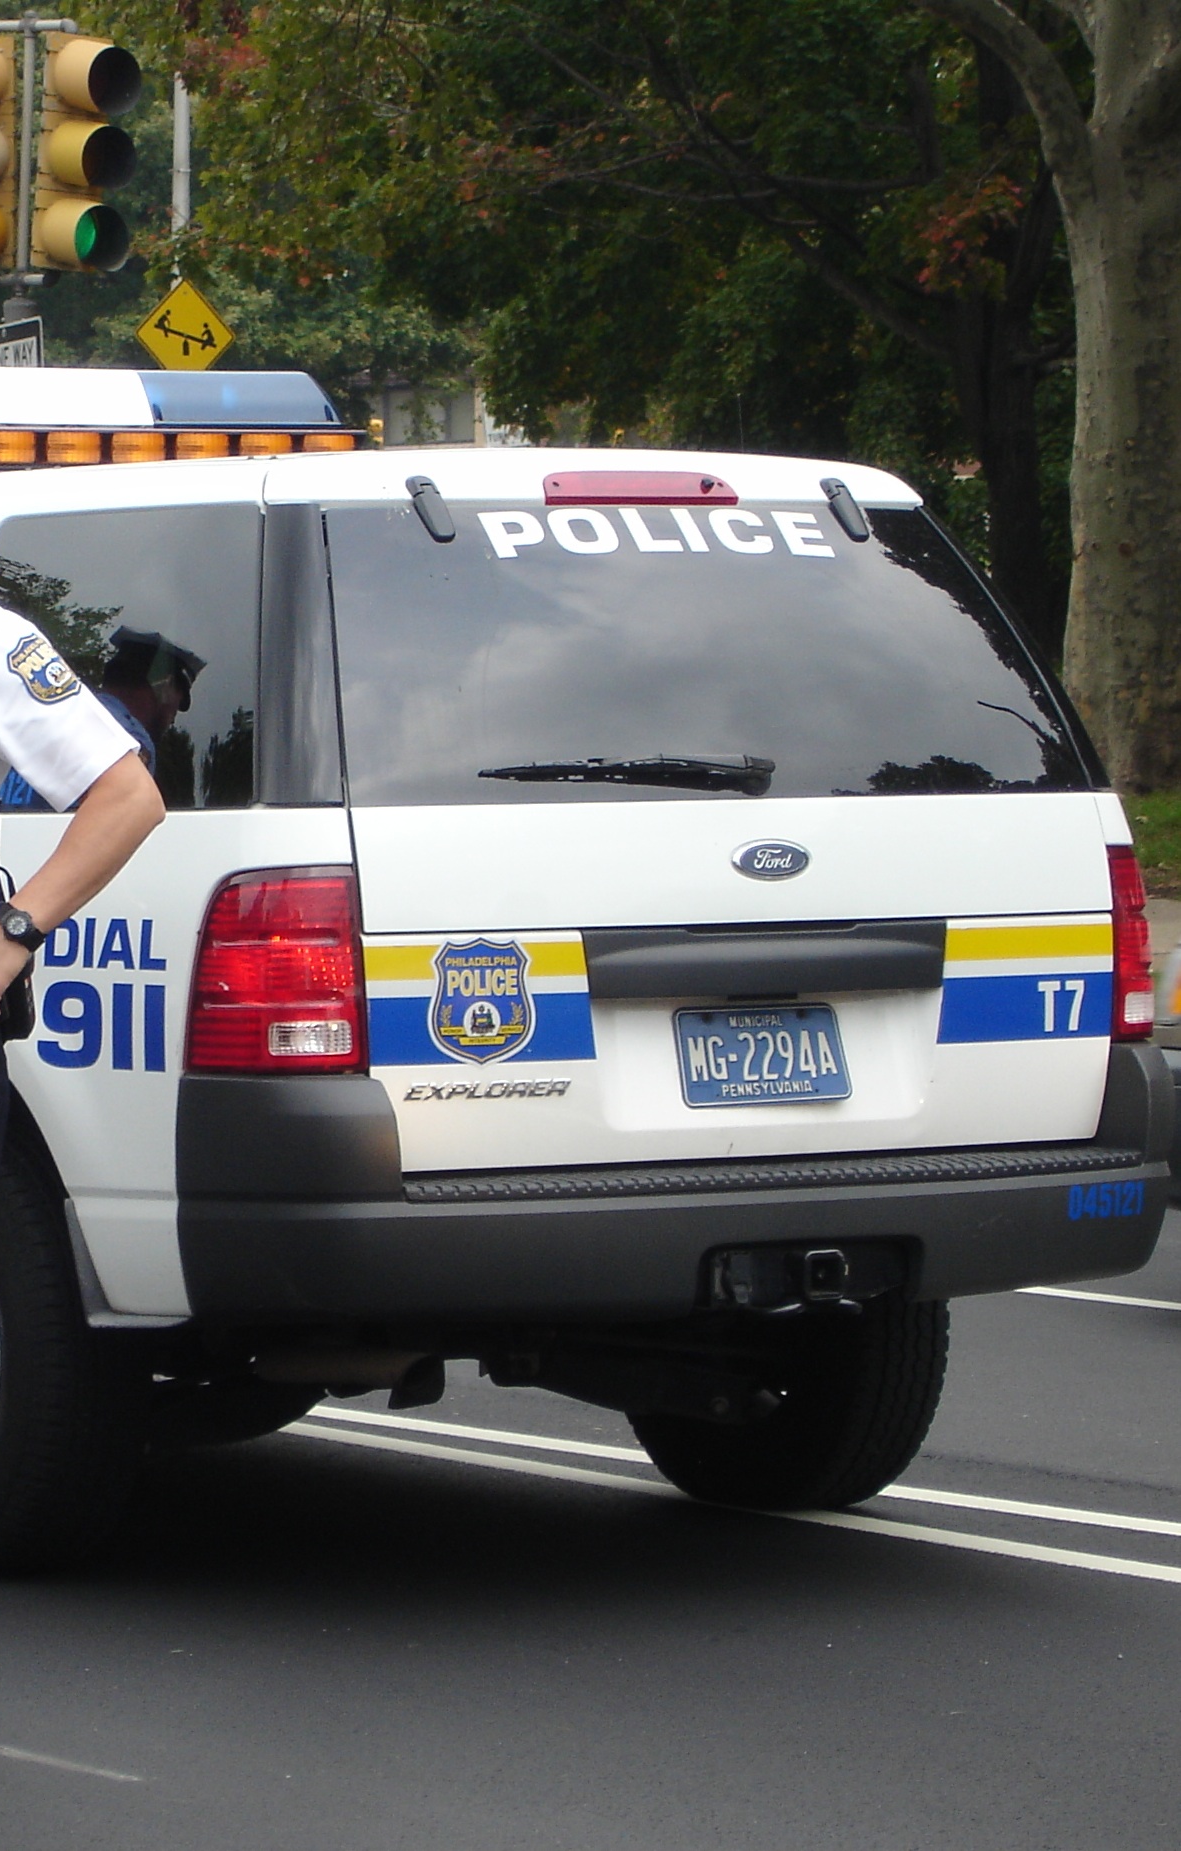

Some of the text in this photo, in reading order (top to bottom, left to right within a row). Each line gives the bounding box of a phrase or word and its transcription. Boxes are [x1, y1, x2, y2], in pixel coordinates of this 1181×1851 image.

[11, 340, 34, 367] WAY
[476, 507, 836, 560] POLICE
[753, 848, 793, 870] Ford
[43, 917, 167, 971] DIAL
[445, 955, 518, 967] PHILADELPHIA
[446, 968, 519, 997] POLICE
[1037, 979, 1085, 1033] T7
[37, 980, 167, 1073] 911
[728, 1014, 783, 1029] MUNICIPAL
[686, 1029, 839, 1084] MG-2294A
[403, 1077, 572, 1102] EXPLORER
[722, 1079, 814, 1098] PENNSYLVANIA
[1068, 1180, 1145, 1222] 045121
